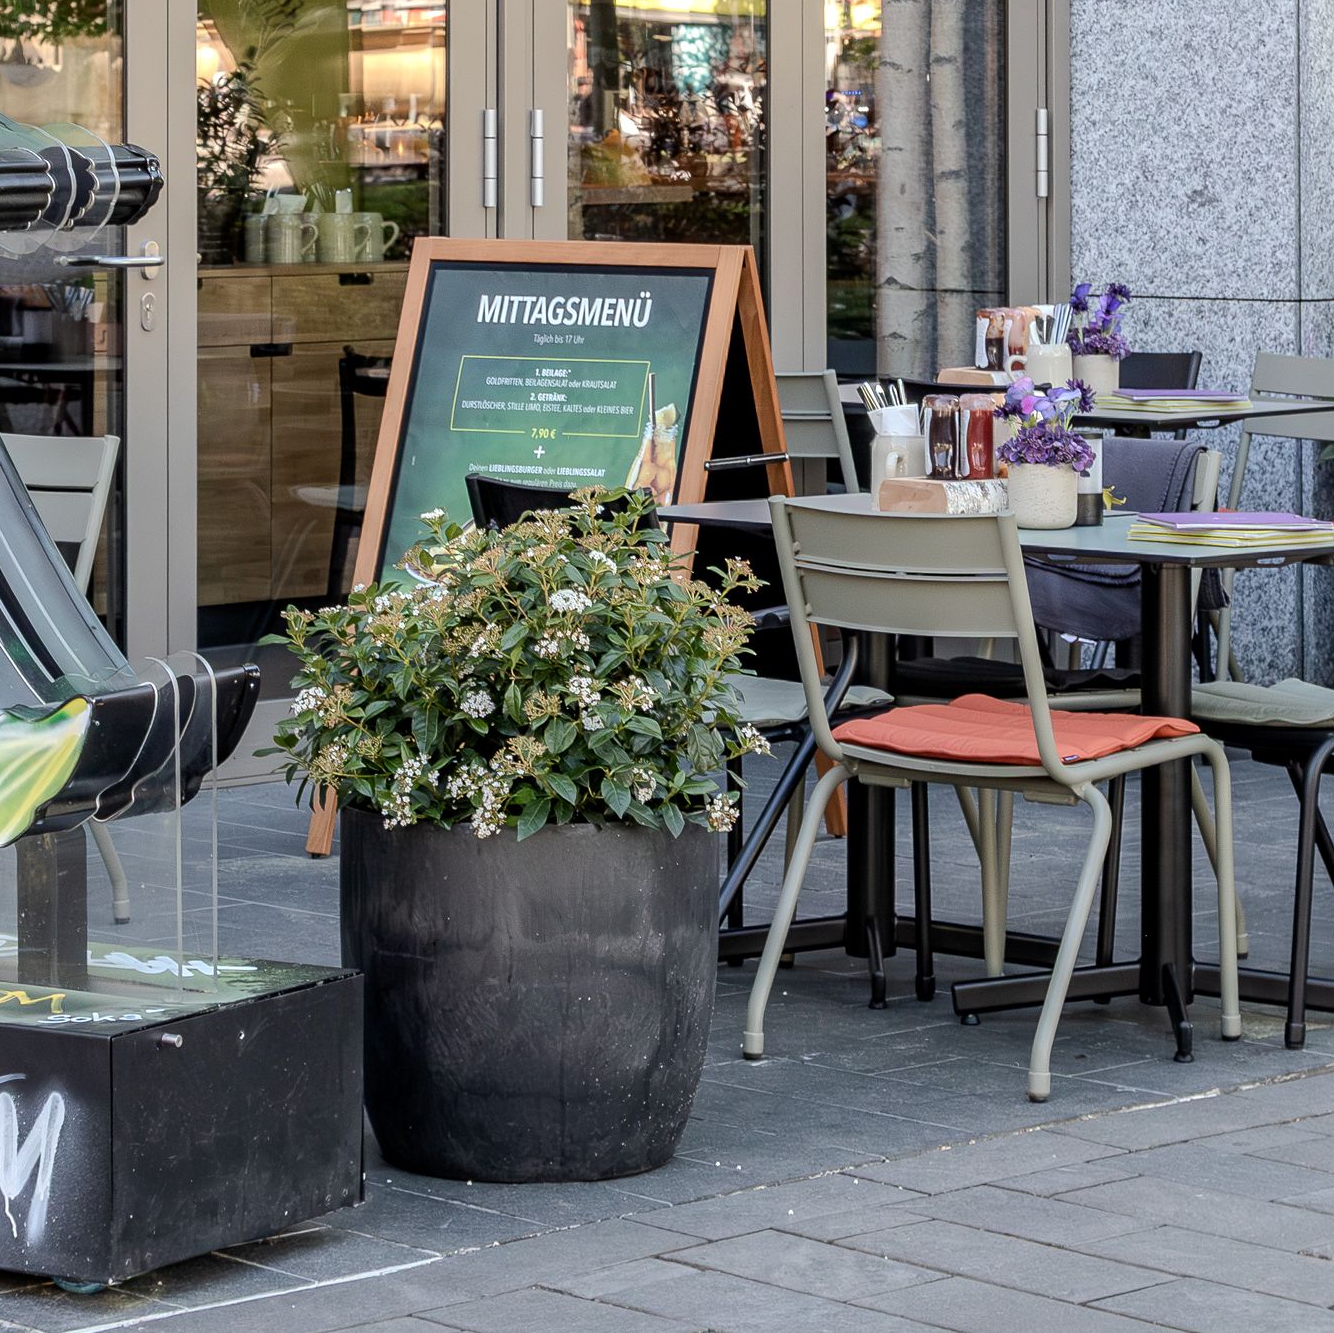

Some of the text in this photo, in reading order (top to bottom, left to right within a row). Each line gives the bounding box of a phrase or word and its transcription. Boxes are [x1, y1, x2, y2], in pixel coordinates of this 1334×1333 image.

[477, 291, 653, 328] MITTAGSMENÜ
[533, 333, 585, 347] Täglich bis 17 Uhr
[535, 368, 541, 377] 1.
[525, 378, 569, 389] BEILAGENSALAT
[568, 380, 581, 389] oder
[581, 380, 617, 390] KRAUTSALAT
[530, 391, 567, 403] 2. GETRÄNK:
[507, 401, 525, 412] STILLE
[562, 404, 583, 414] KALTES
[582, 405, 596, 414] oder
[597, 405, 619, 415] KLEINES
[620, 406, 635, 416] BIER
[531, 428, 557, 440] 7,90 €
[468, 463, 606, 478] Deinen LIEBLINGSBURGER oder LIEBLINGSSALAT
[549, 478, 563, 489] Preis
